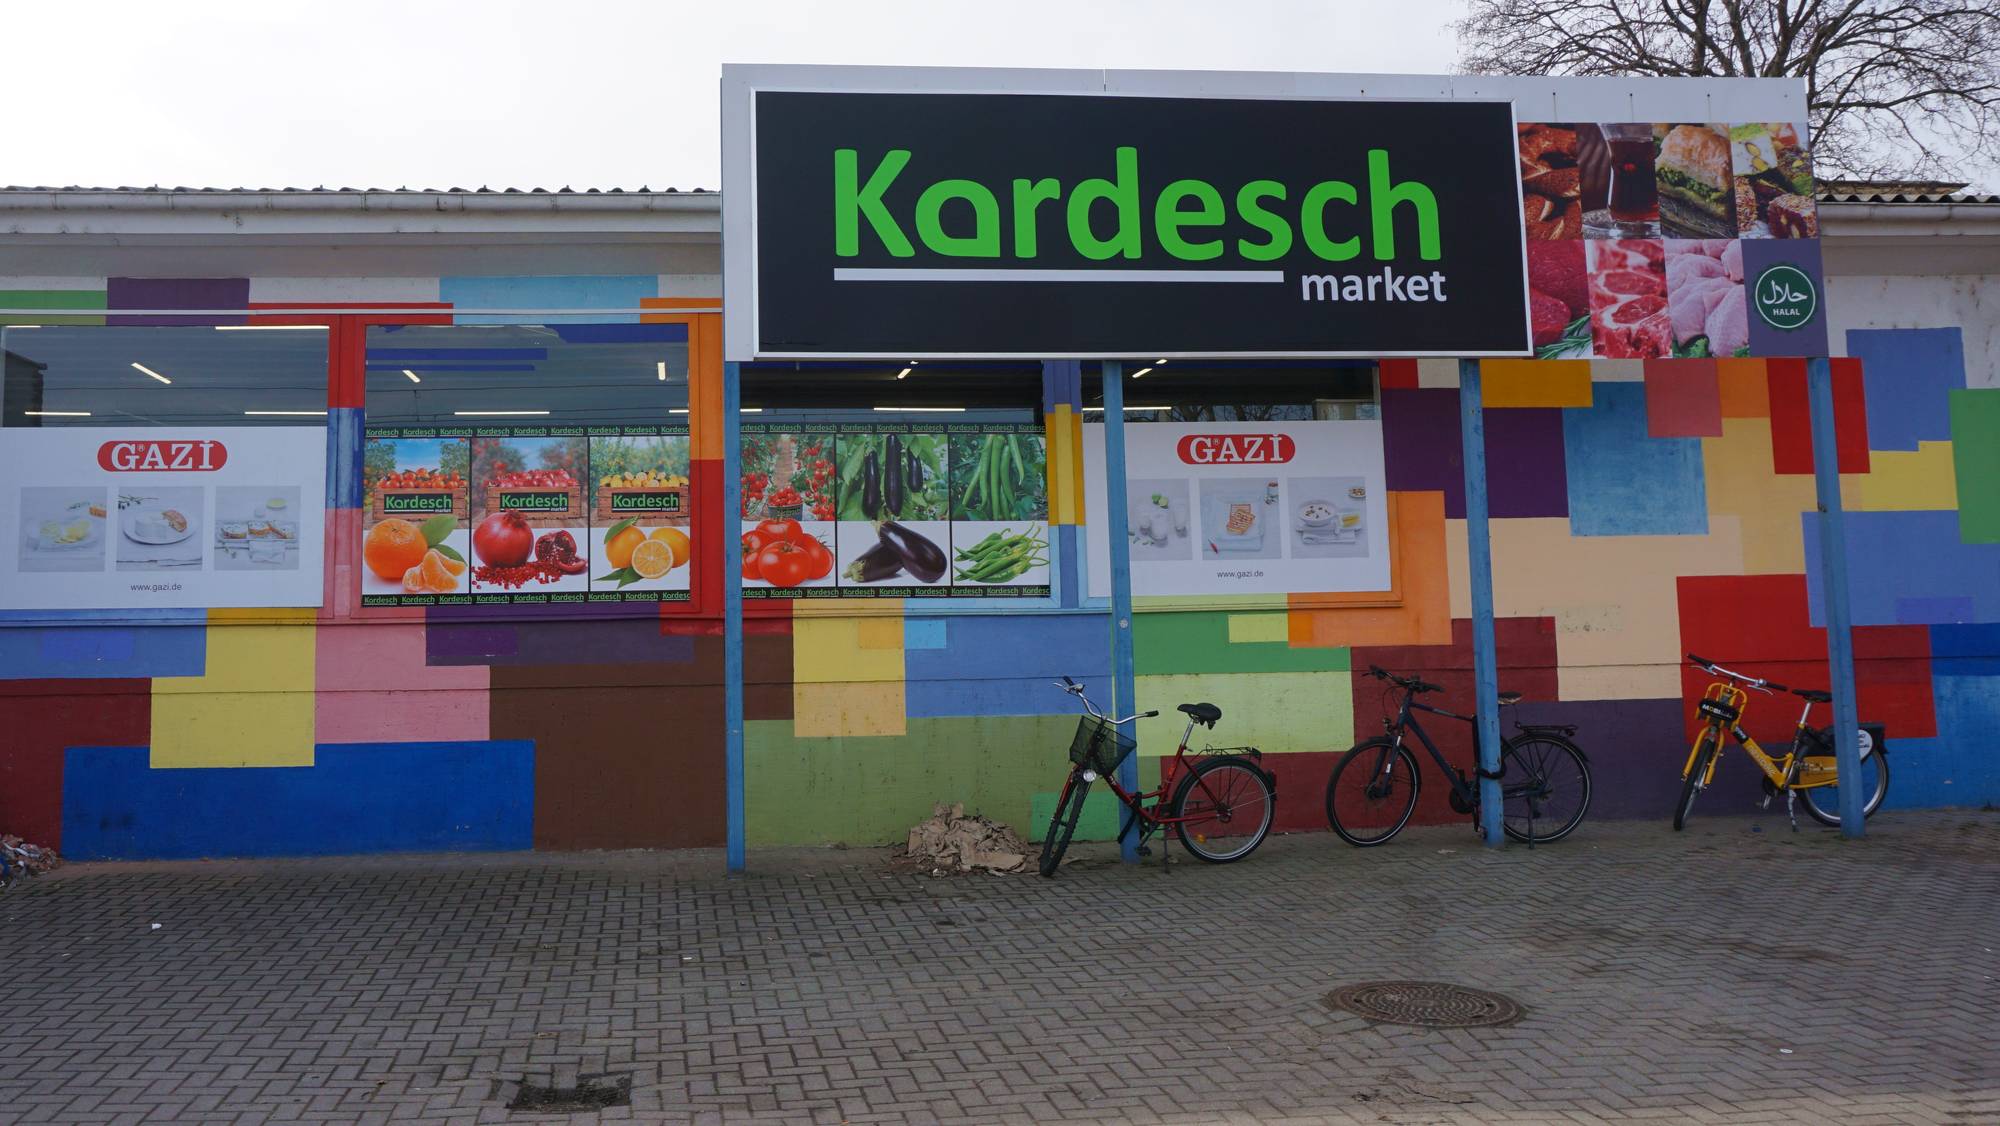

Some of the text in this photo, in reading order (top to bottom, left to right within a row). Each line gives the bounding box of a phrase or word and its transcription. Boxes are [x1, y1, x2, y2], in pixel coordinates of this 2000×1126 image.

[834, 146, 1442, 262] Kardesch
[1302, 265, 1447, 303] market
[1762, 279, 1808, 304] حلال
[1773, 308, 1800, 316] HALAL
[386, 494, 452, 509] Kardesch
[502, 493, 567, 507] Kardesch
[614, 494, 678, 507] Kardesch
[1217, 570, 1264, 579] www.gazi.de
[130, 583, 182, 592] www.gazi.de
